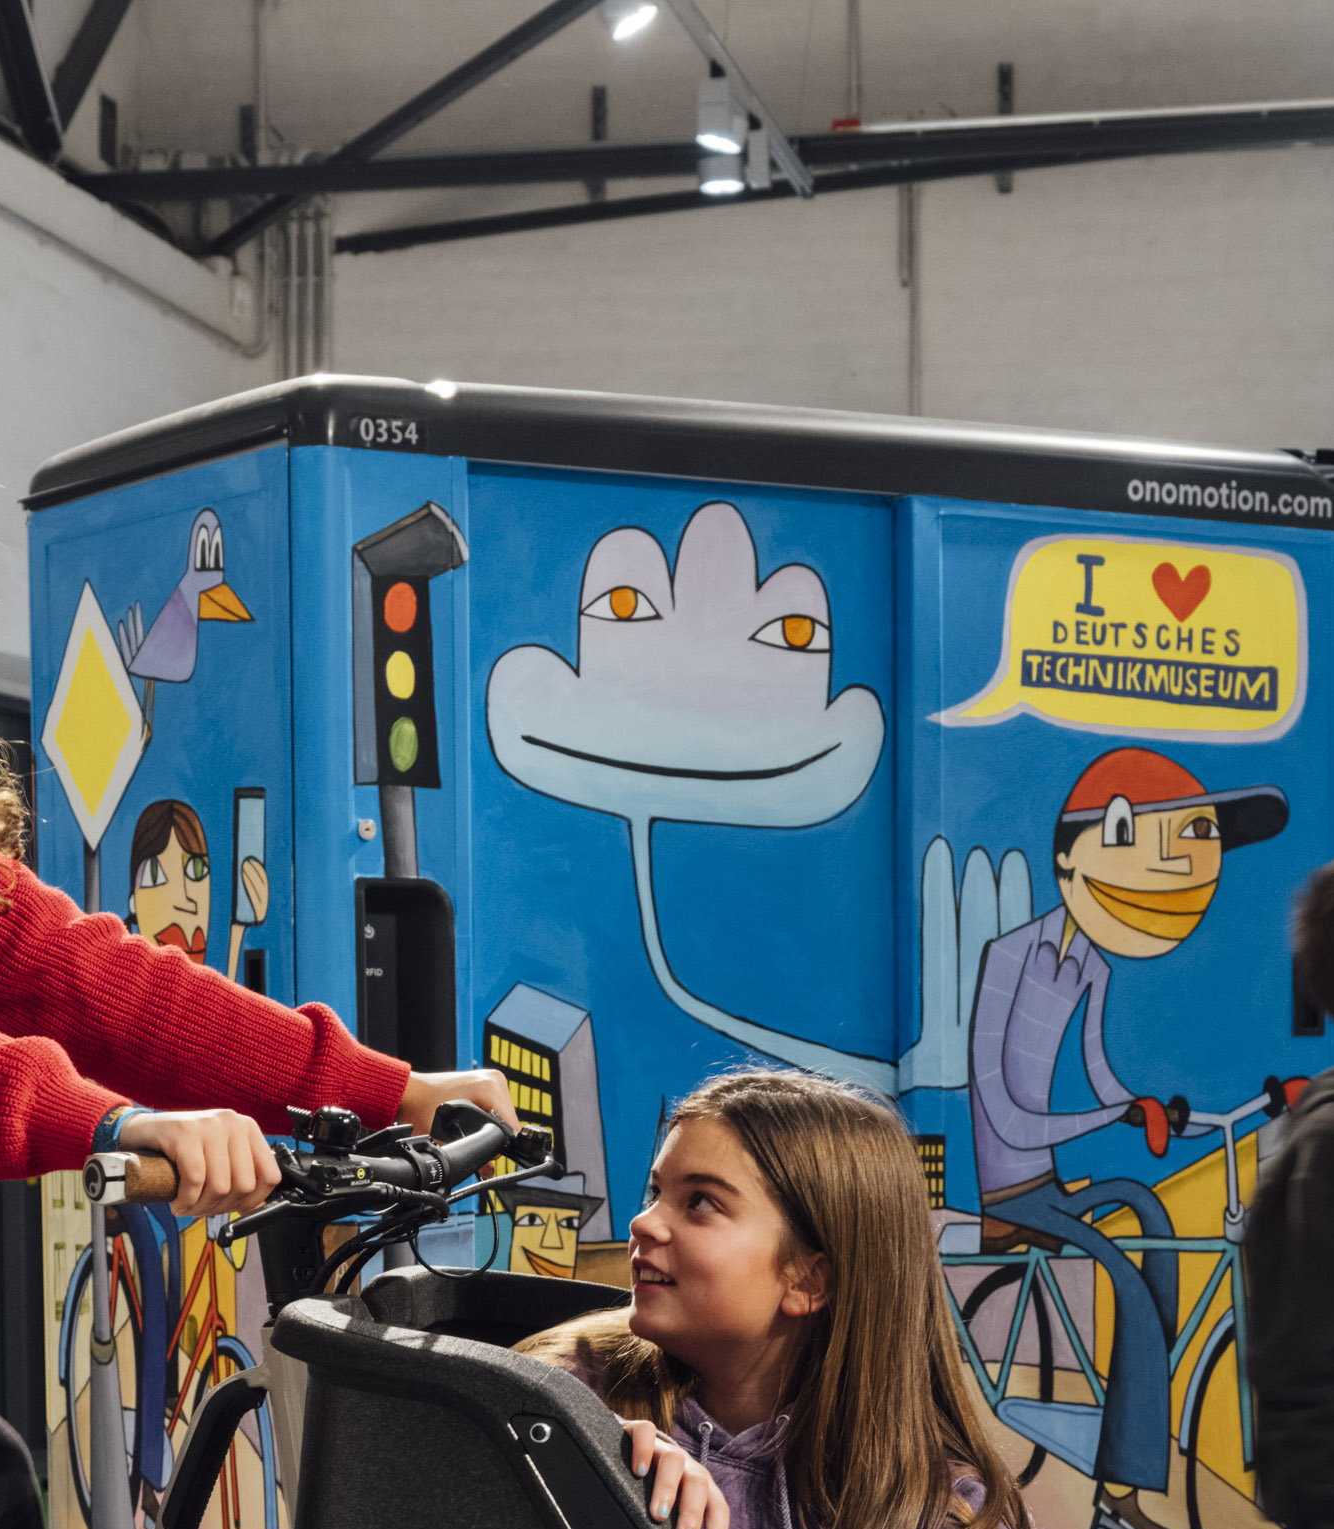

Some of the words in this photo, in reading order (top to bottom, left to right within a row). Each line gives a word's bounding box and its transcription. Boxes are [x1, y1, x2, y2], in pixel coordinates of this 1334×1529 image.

[359, 418, 419, 446] 0354
[1127, 478, 1333, 519] onomotion.com
[1076, 553, 1106, 616] I
[1052, 620, 1241, 656] DEUTSCHES
[1025, 656, 1271, 703] TECHNIKMUSEUM
